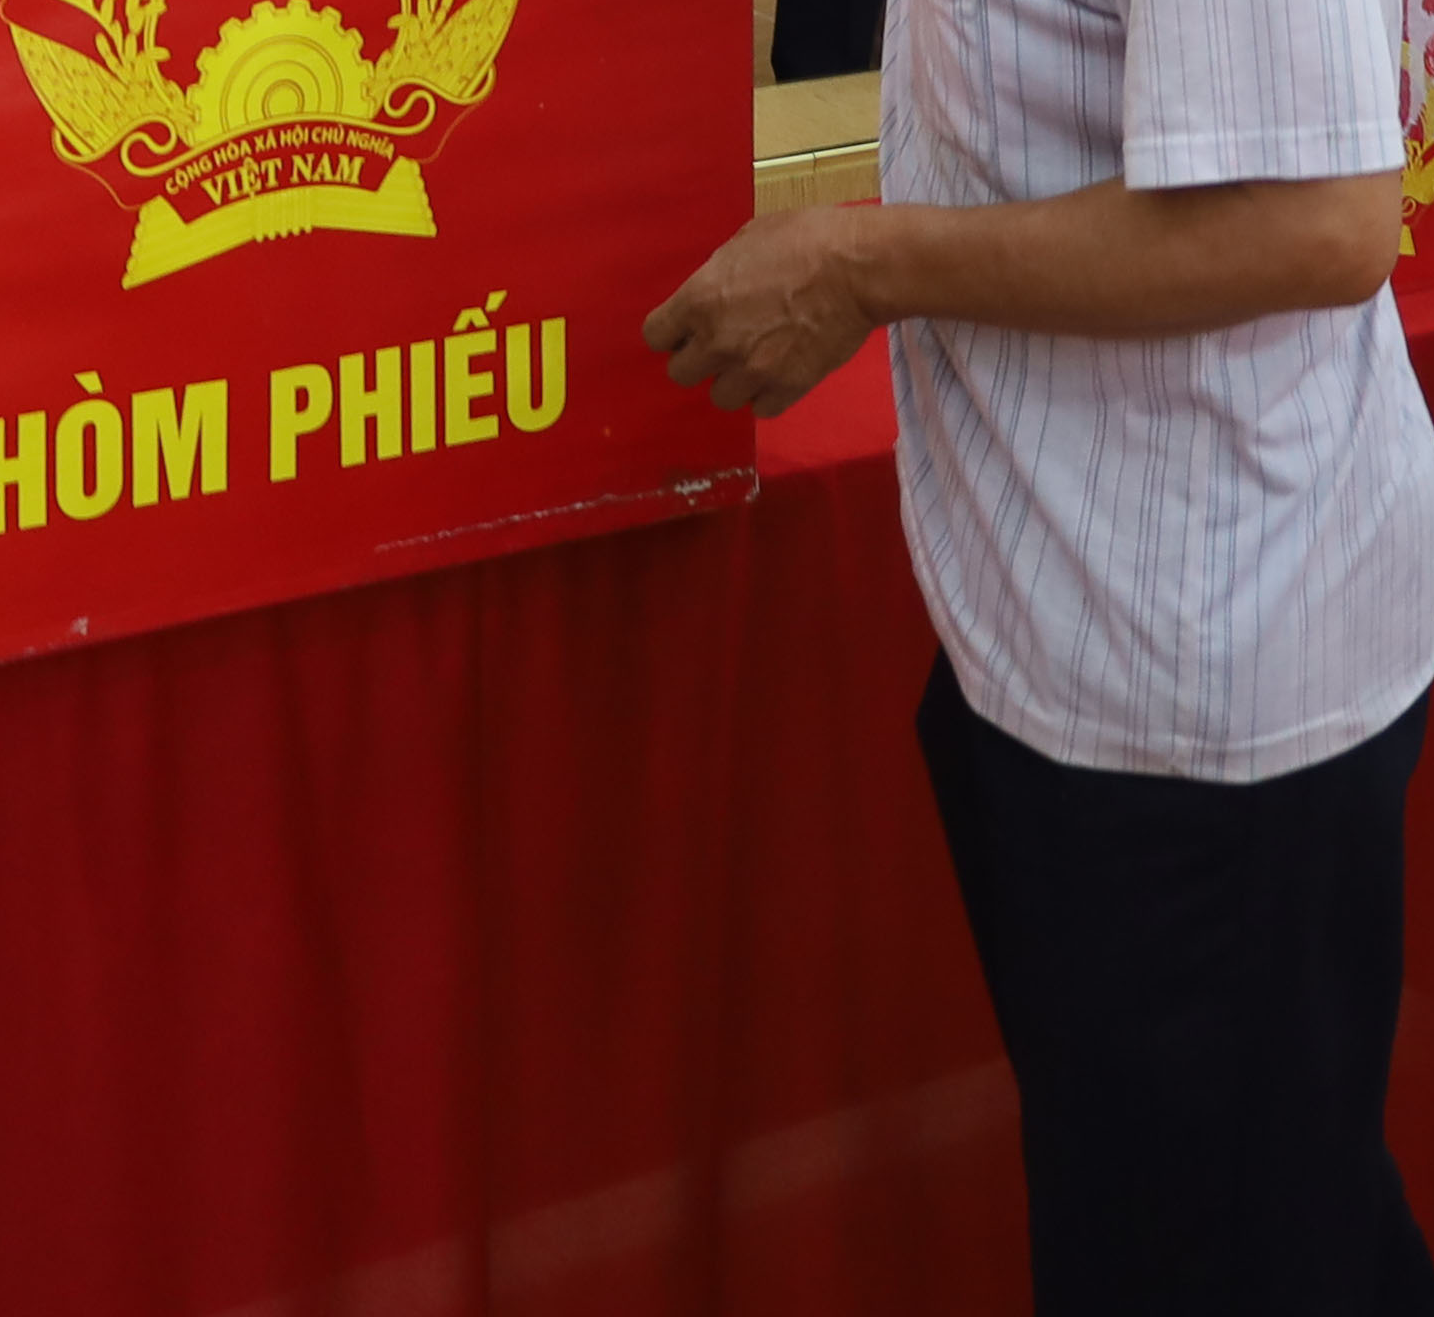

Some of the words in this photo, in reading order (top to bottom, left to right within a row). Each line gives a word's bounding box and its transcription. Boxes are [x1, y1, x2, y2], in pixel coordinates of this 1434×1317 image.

[166, 155, 212, 195] CỘNG
[213, 139, 252, 166] HÒA
[254, 129, 277, 153] XÃ
[280, 124, 309, 149] HỘI
[311, 124, 344, 145] CHỦ
[346, 131, 395, 161] NGHĨA
[200, 155, 282, 206] VIỆT
[290, 153, 365, 185] NAM
[270, 291, 566, 481] PHIẾU
